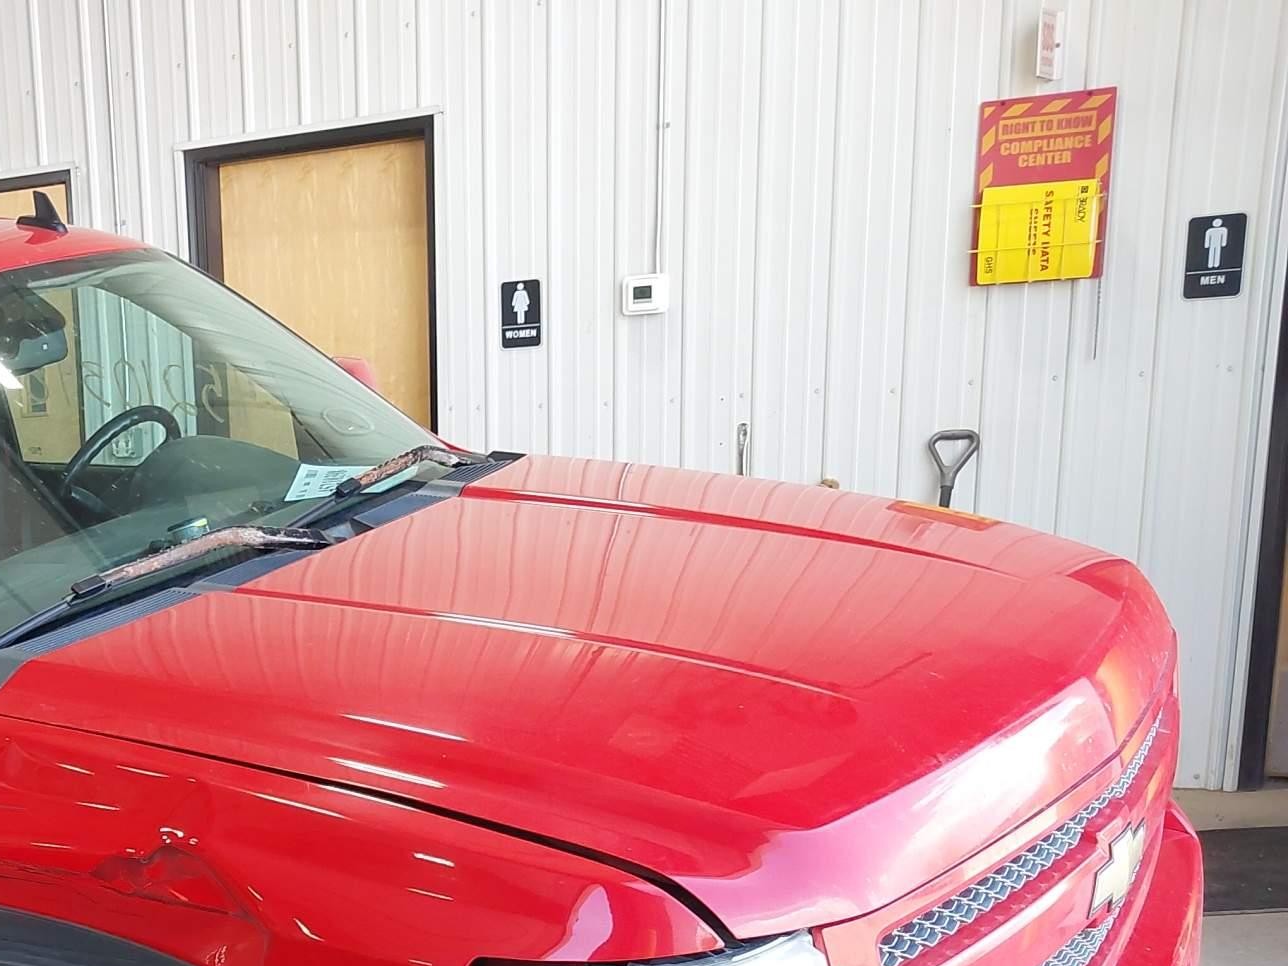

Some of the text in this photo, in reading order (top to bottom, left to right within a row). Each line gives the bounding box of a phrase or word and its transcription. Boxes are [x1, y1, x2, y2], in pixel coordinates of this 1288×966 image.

[1002, 115, 1092, 136] RIGHT TO KNOW
[1000, 134, 1092, 155] COMPLIANCE
[1018, 151, 1072, 168] CENTER
[1042, 190, 1055, 237] SAFETY
[1200, 275, 1226, 286] MEN
[505, 328, 537, 339] WOMEN
